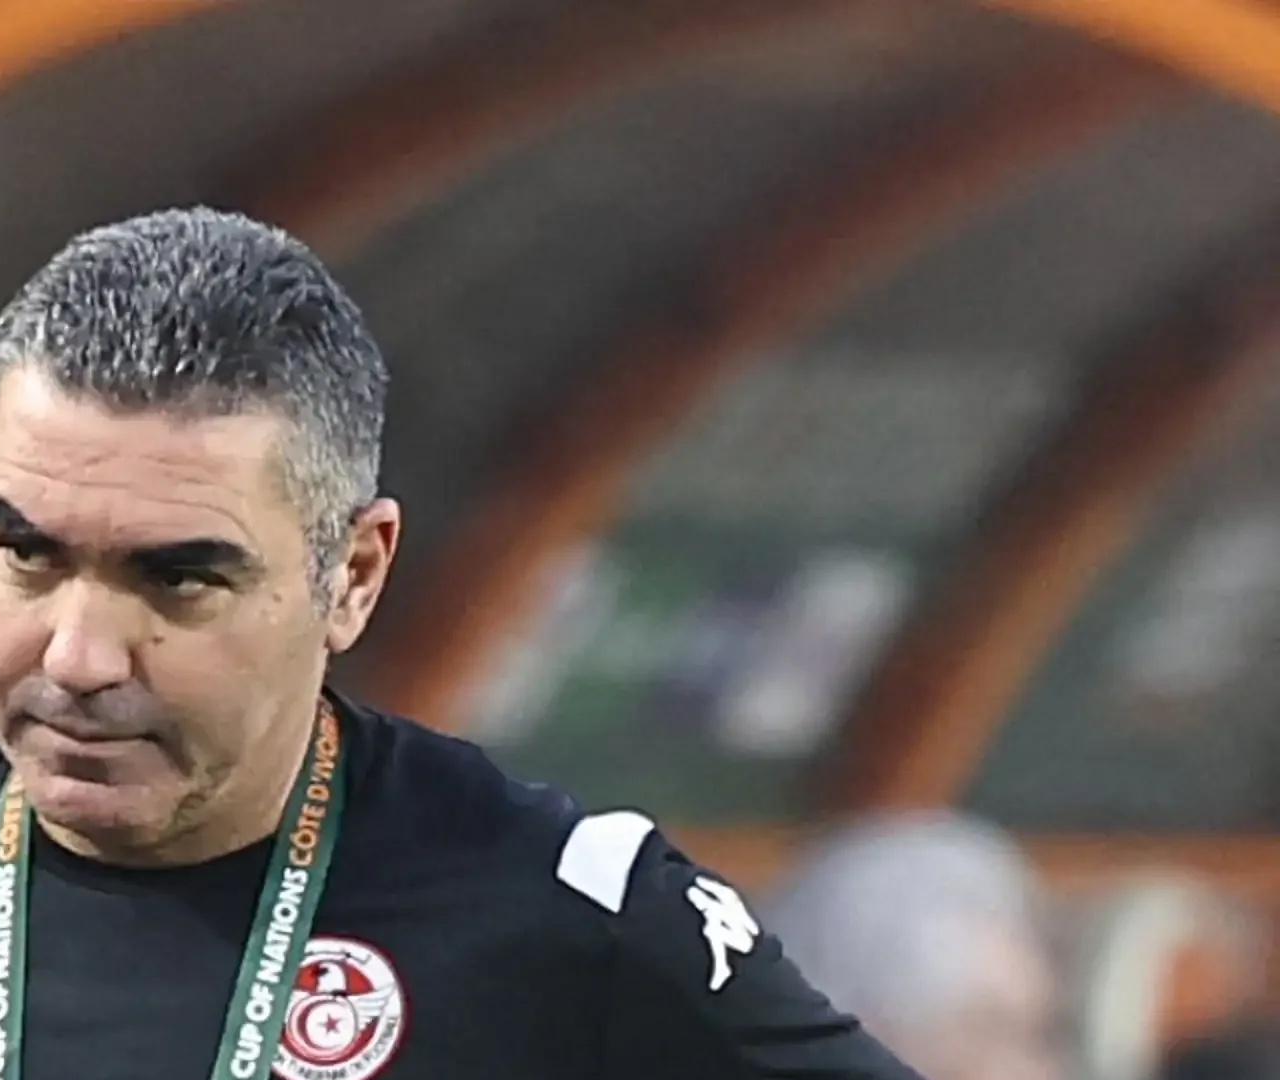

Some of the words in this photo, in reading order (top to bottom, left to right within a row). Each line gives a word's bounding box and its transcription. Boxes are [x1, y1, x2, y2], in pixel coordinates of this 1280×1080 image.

[256, 867, 309, 984] NATIONS
[245, 981, 274, 1022] OF
[230, 1022, 264, 1079] CUP
